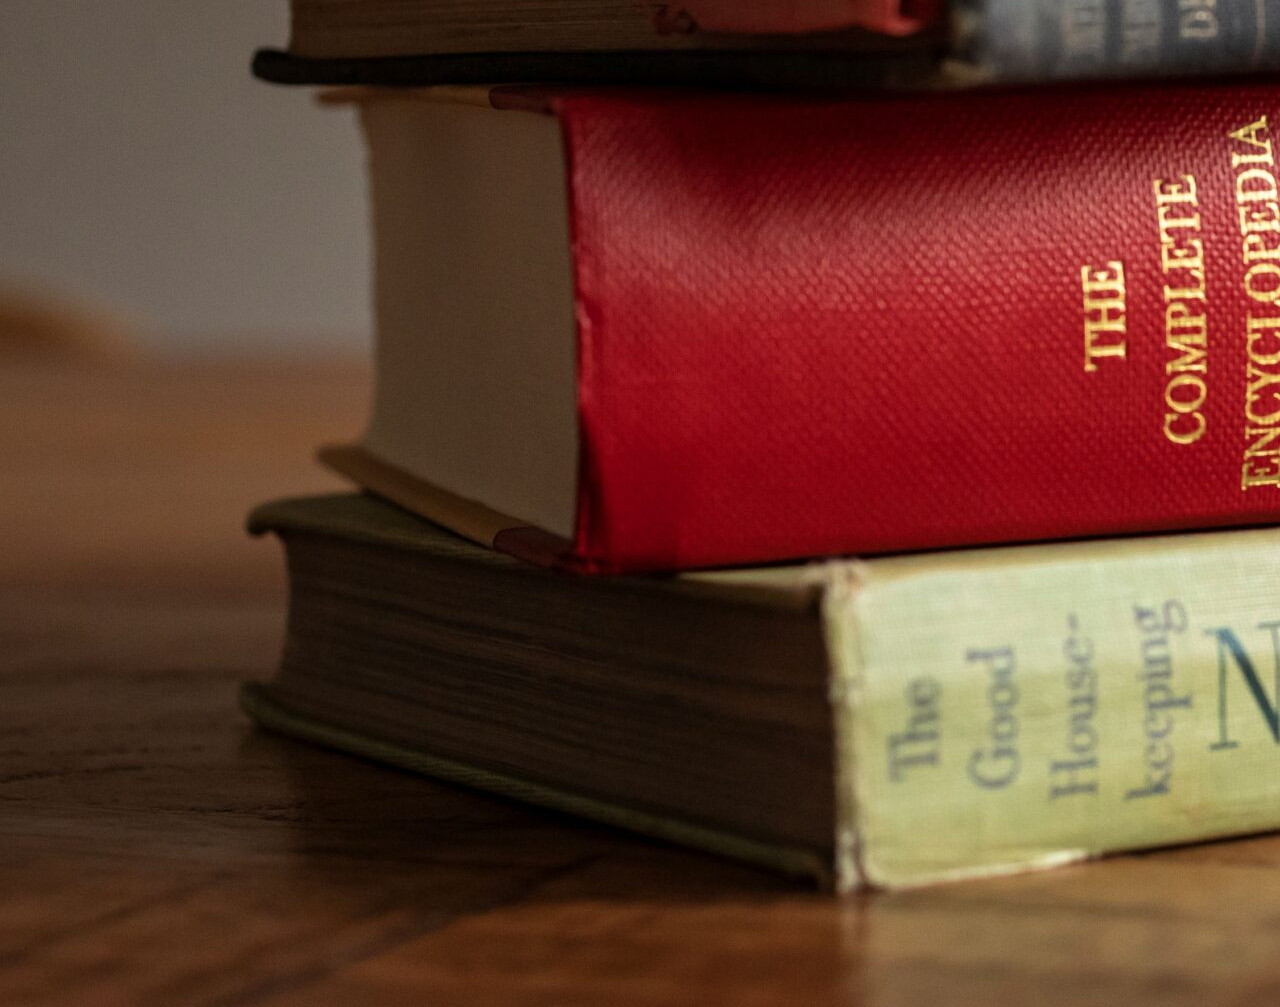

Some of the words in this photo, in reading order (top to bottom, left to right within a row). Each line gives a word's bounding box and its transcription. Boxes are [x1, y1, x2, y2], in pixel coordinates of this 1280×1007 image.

[1081, 260, 1126, 372] THE
[1154, 174, 1207, 444] COMPLETE
[887, 675, 942, 782] The
[966, 647, 1020, 789] Good
[1049, 612, 1099, 803] House-
[1122, 599, 1192, 802] keeping
